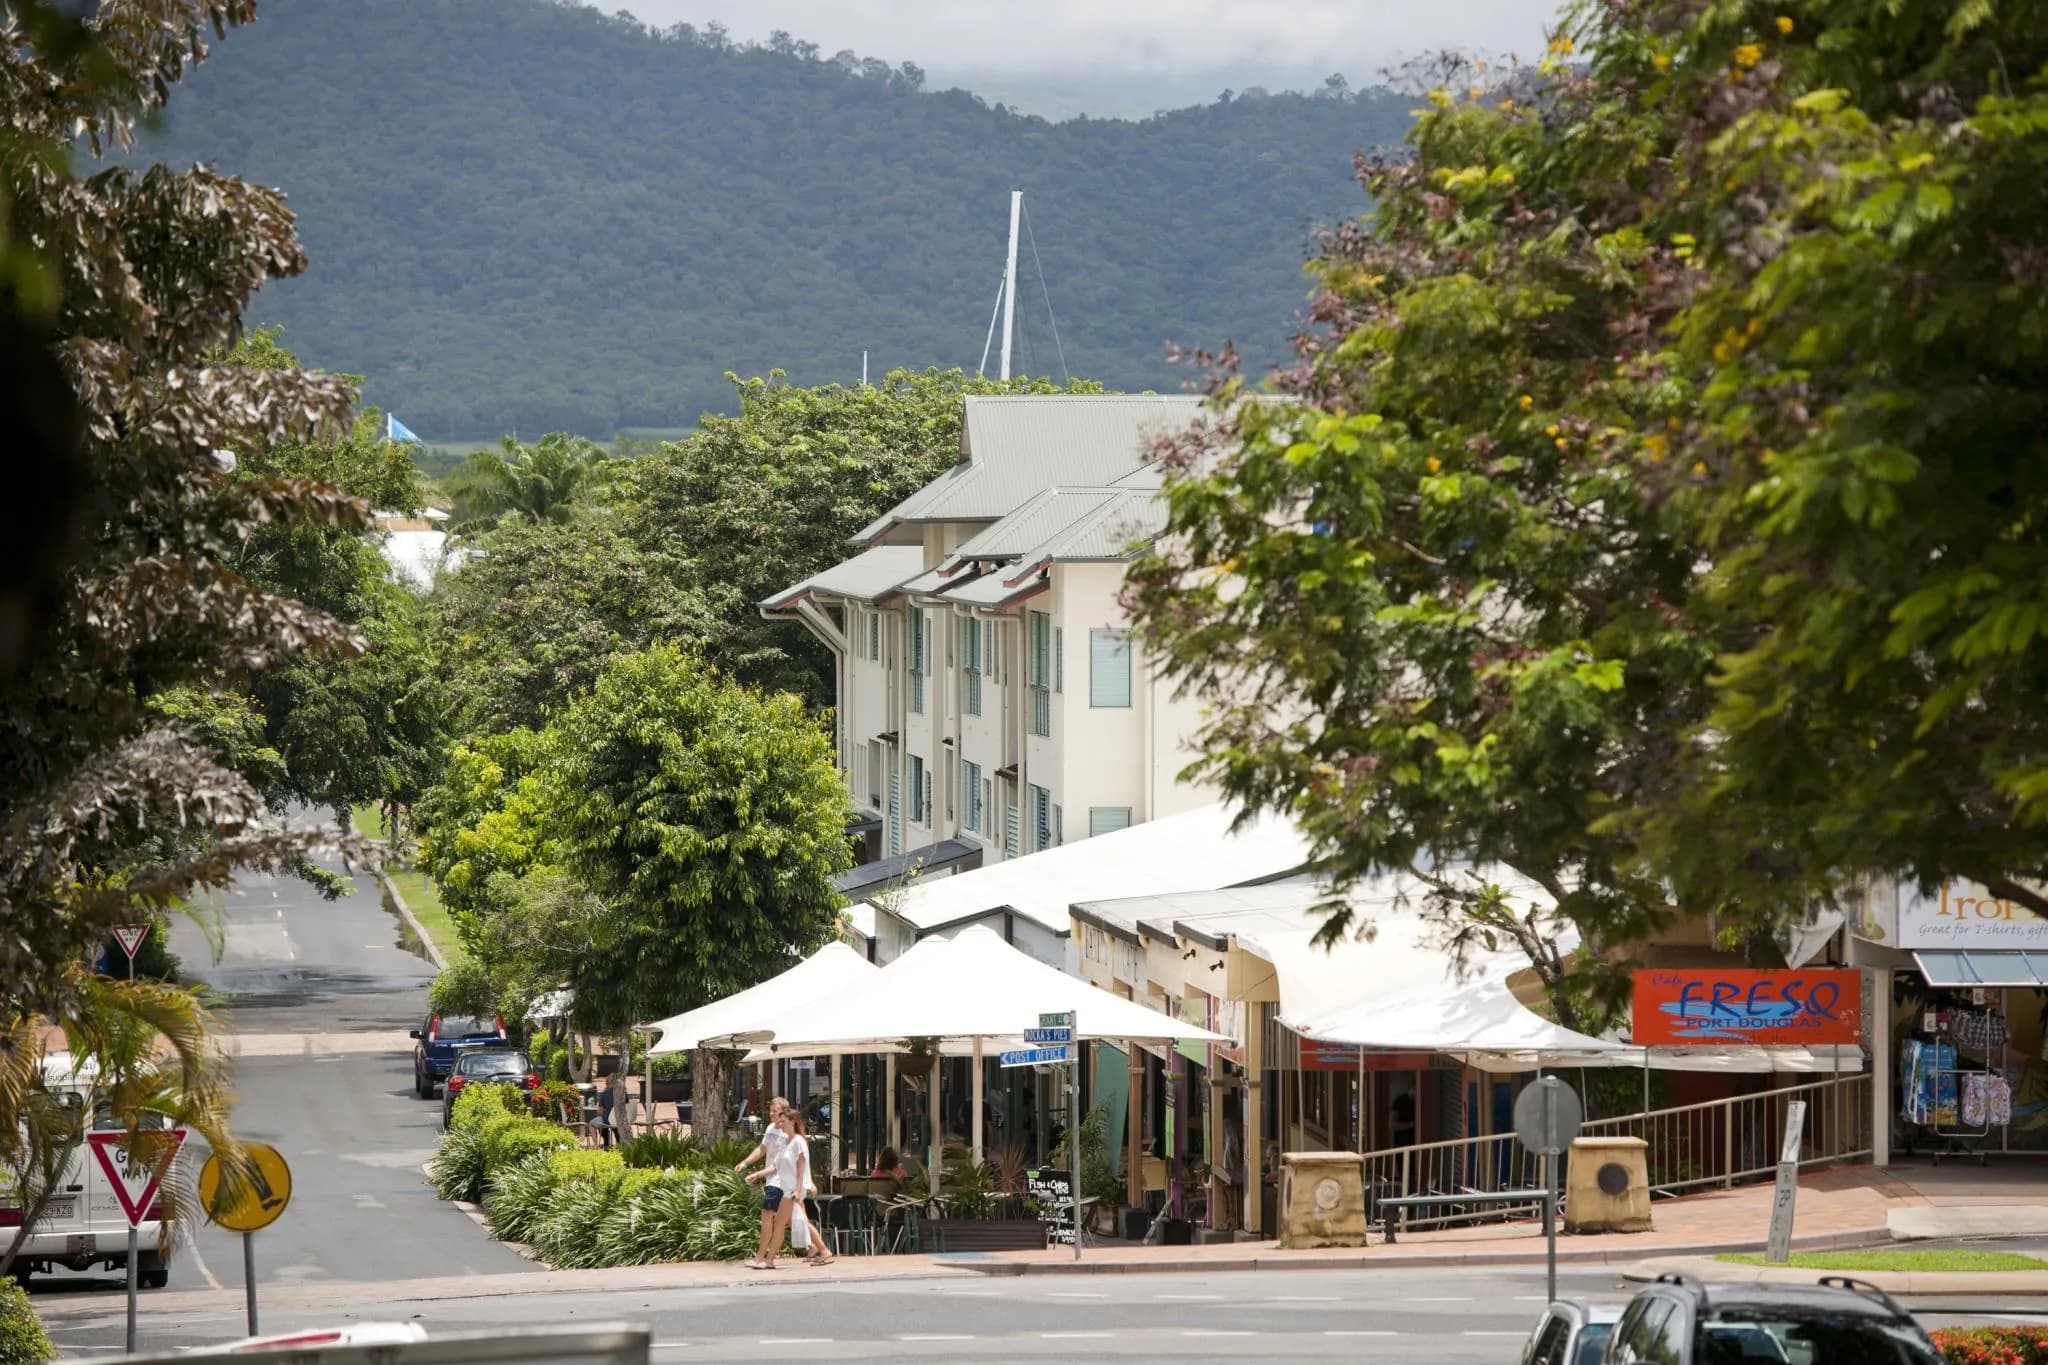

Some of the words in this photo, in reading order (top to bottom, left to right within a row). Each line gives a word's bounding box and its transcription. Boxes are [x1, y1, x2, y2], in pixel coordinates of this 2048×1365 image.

[1919, 923, 1951, 936] Great
[1952, 923, 1969, 940] for
[1686, 1017, 1735, 1028] PORT
[1739, 1017, 1822, 1028] DOUGLAS
[1053, 1028, 1068, 1040] PIES
[1010, 1051, 1030, 1063] POST
[1035, 1047, 1062, 1061] OFFICE
[121, 1167, 150, 1180] WAY
